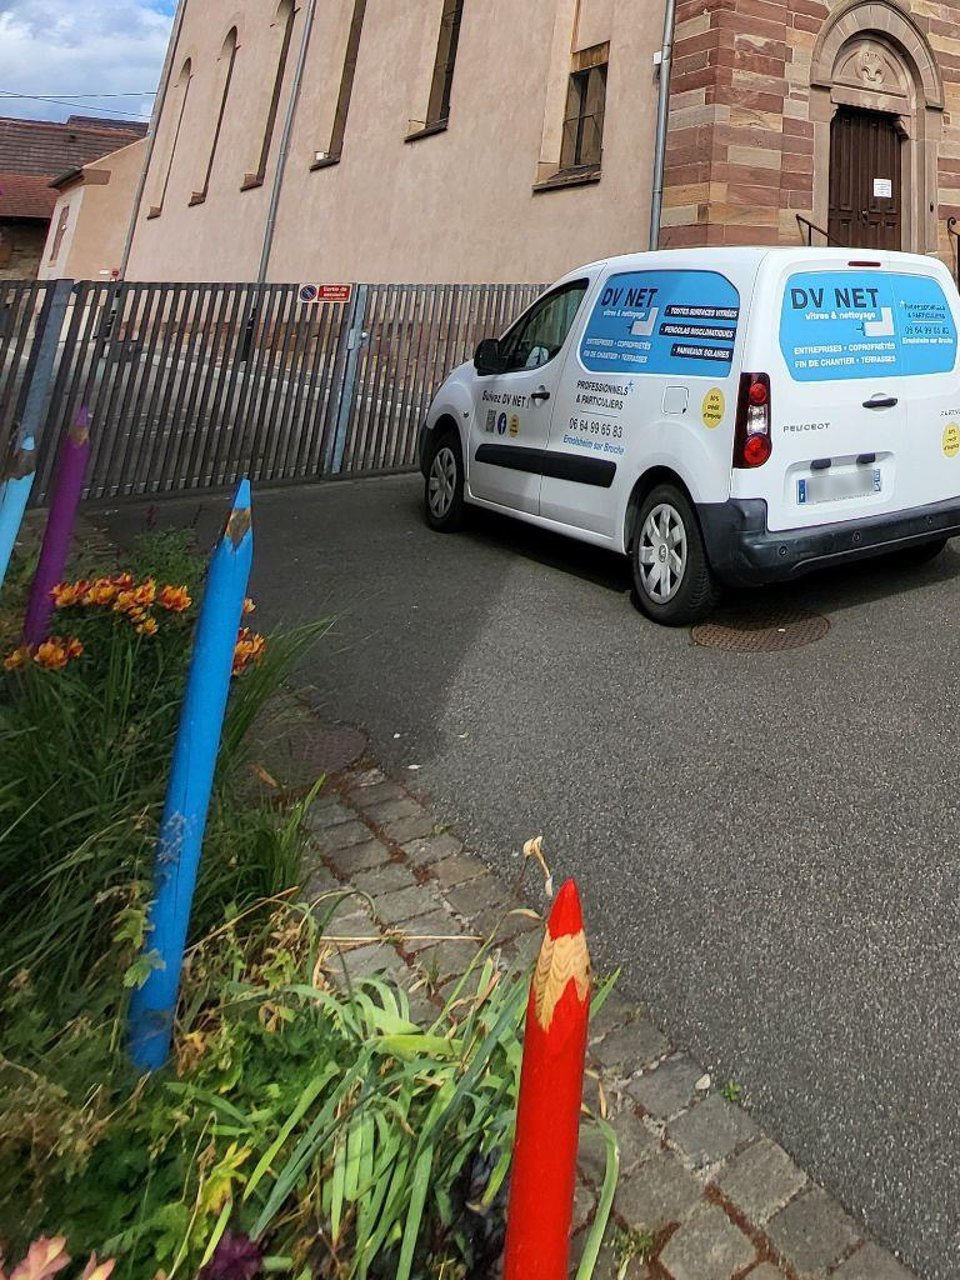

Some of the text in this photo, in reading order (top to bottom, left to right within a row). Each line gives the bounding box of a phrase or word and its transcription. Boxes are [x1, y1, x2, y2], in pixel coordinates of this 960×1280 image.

[601, 288, 659, 307] DV NET
[790, 288, 879, 309] DV NET
[805, 310, 876, 321] vitres & nettoyage
[793, 341, 896, 355] ENTREPRISES COPROPRIÉTÉS
[794, 354, 896, 369] FIN DE CHANTIER TERRASSES
[576, 380, 629, 396] PROFESSIONNELS
[482, 390, 501, 402] Suivez
[502, 393, 512, 406] DV
[512, 394, 526, 407] NET
[581, 394, 624, 410] PARTICULIERS
[569, 417, 623, 438] 06 64 99 65 83
[783, 422, 831, 432] PEUGEOT
